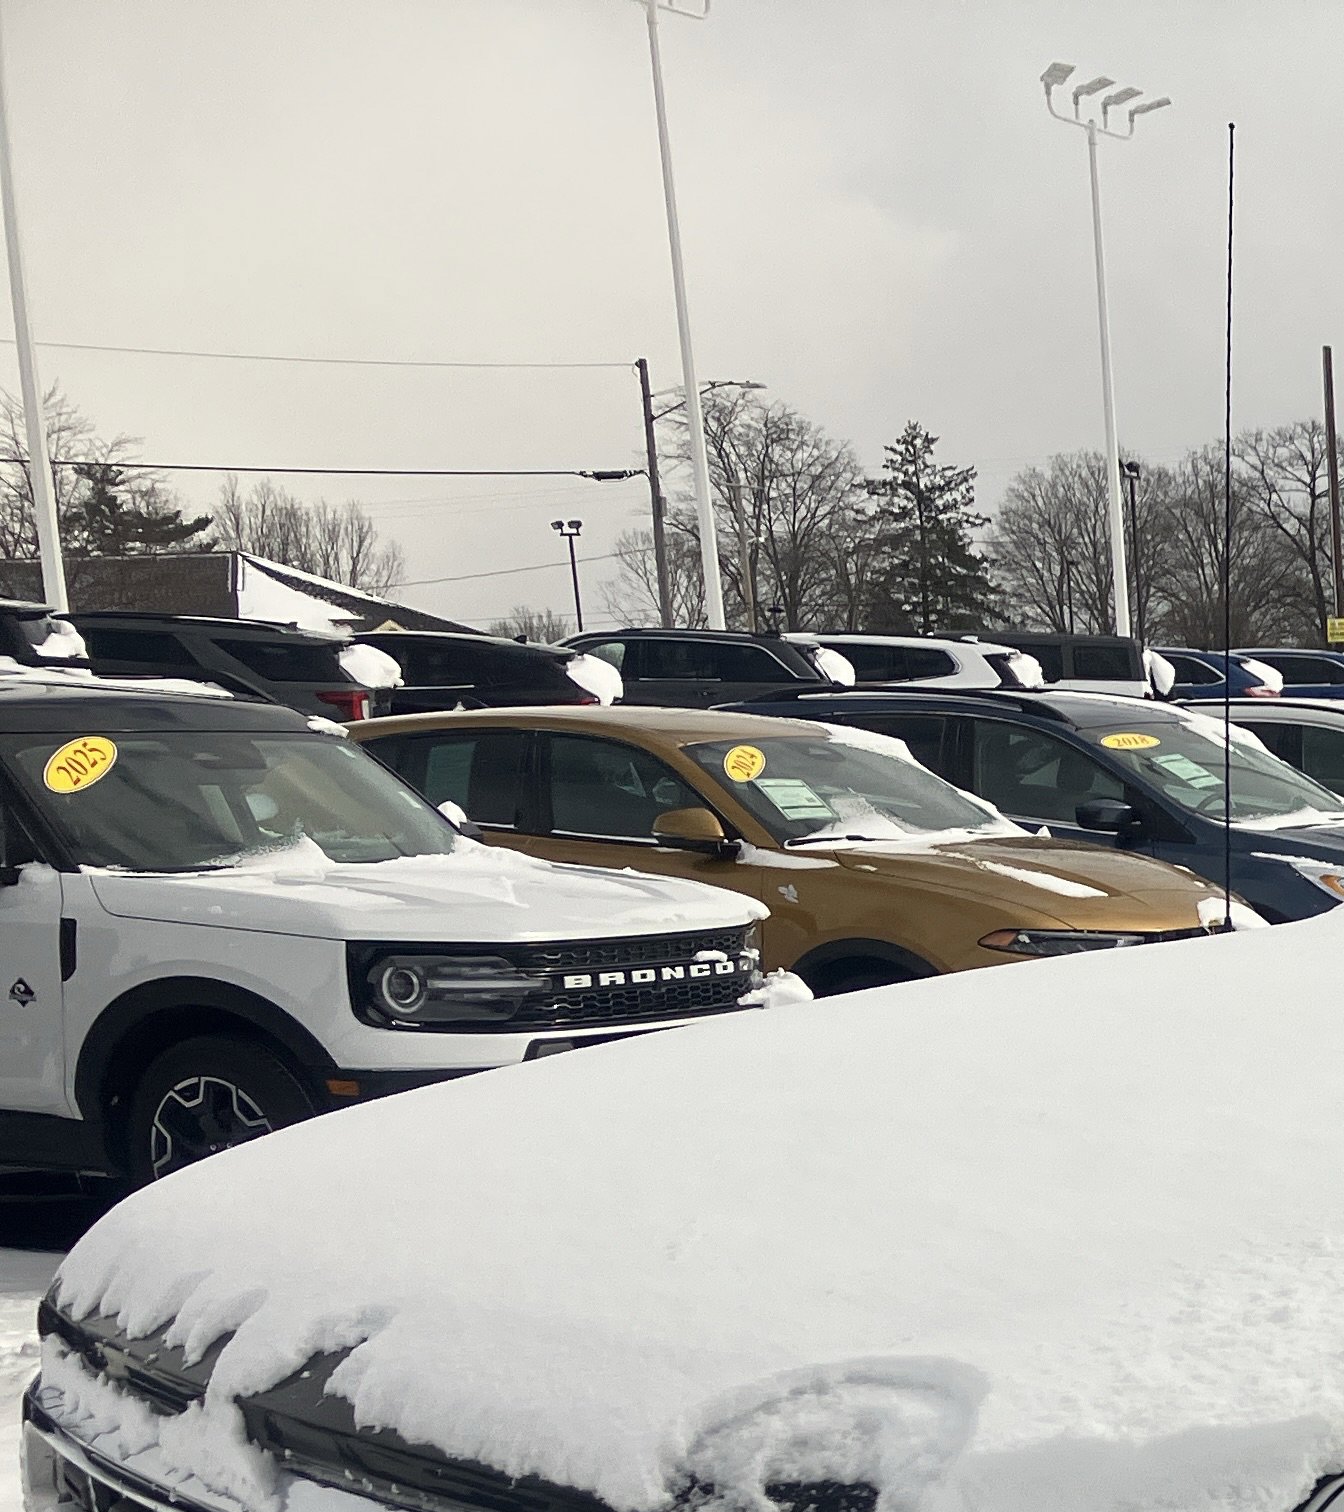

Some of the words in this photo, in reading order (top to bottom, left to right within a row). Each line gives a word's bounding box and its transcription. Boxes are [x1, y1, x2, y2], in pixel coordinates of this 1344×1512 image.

[56, 741, 107, 786] 2025
[731, 748, 757, 778] 2024
[563, 961, 735, 989] BRONCO
